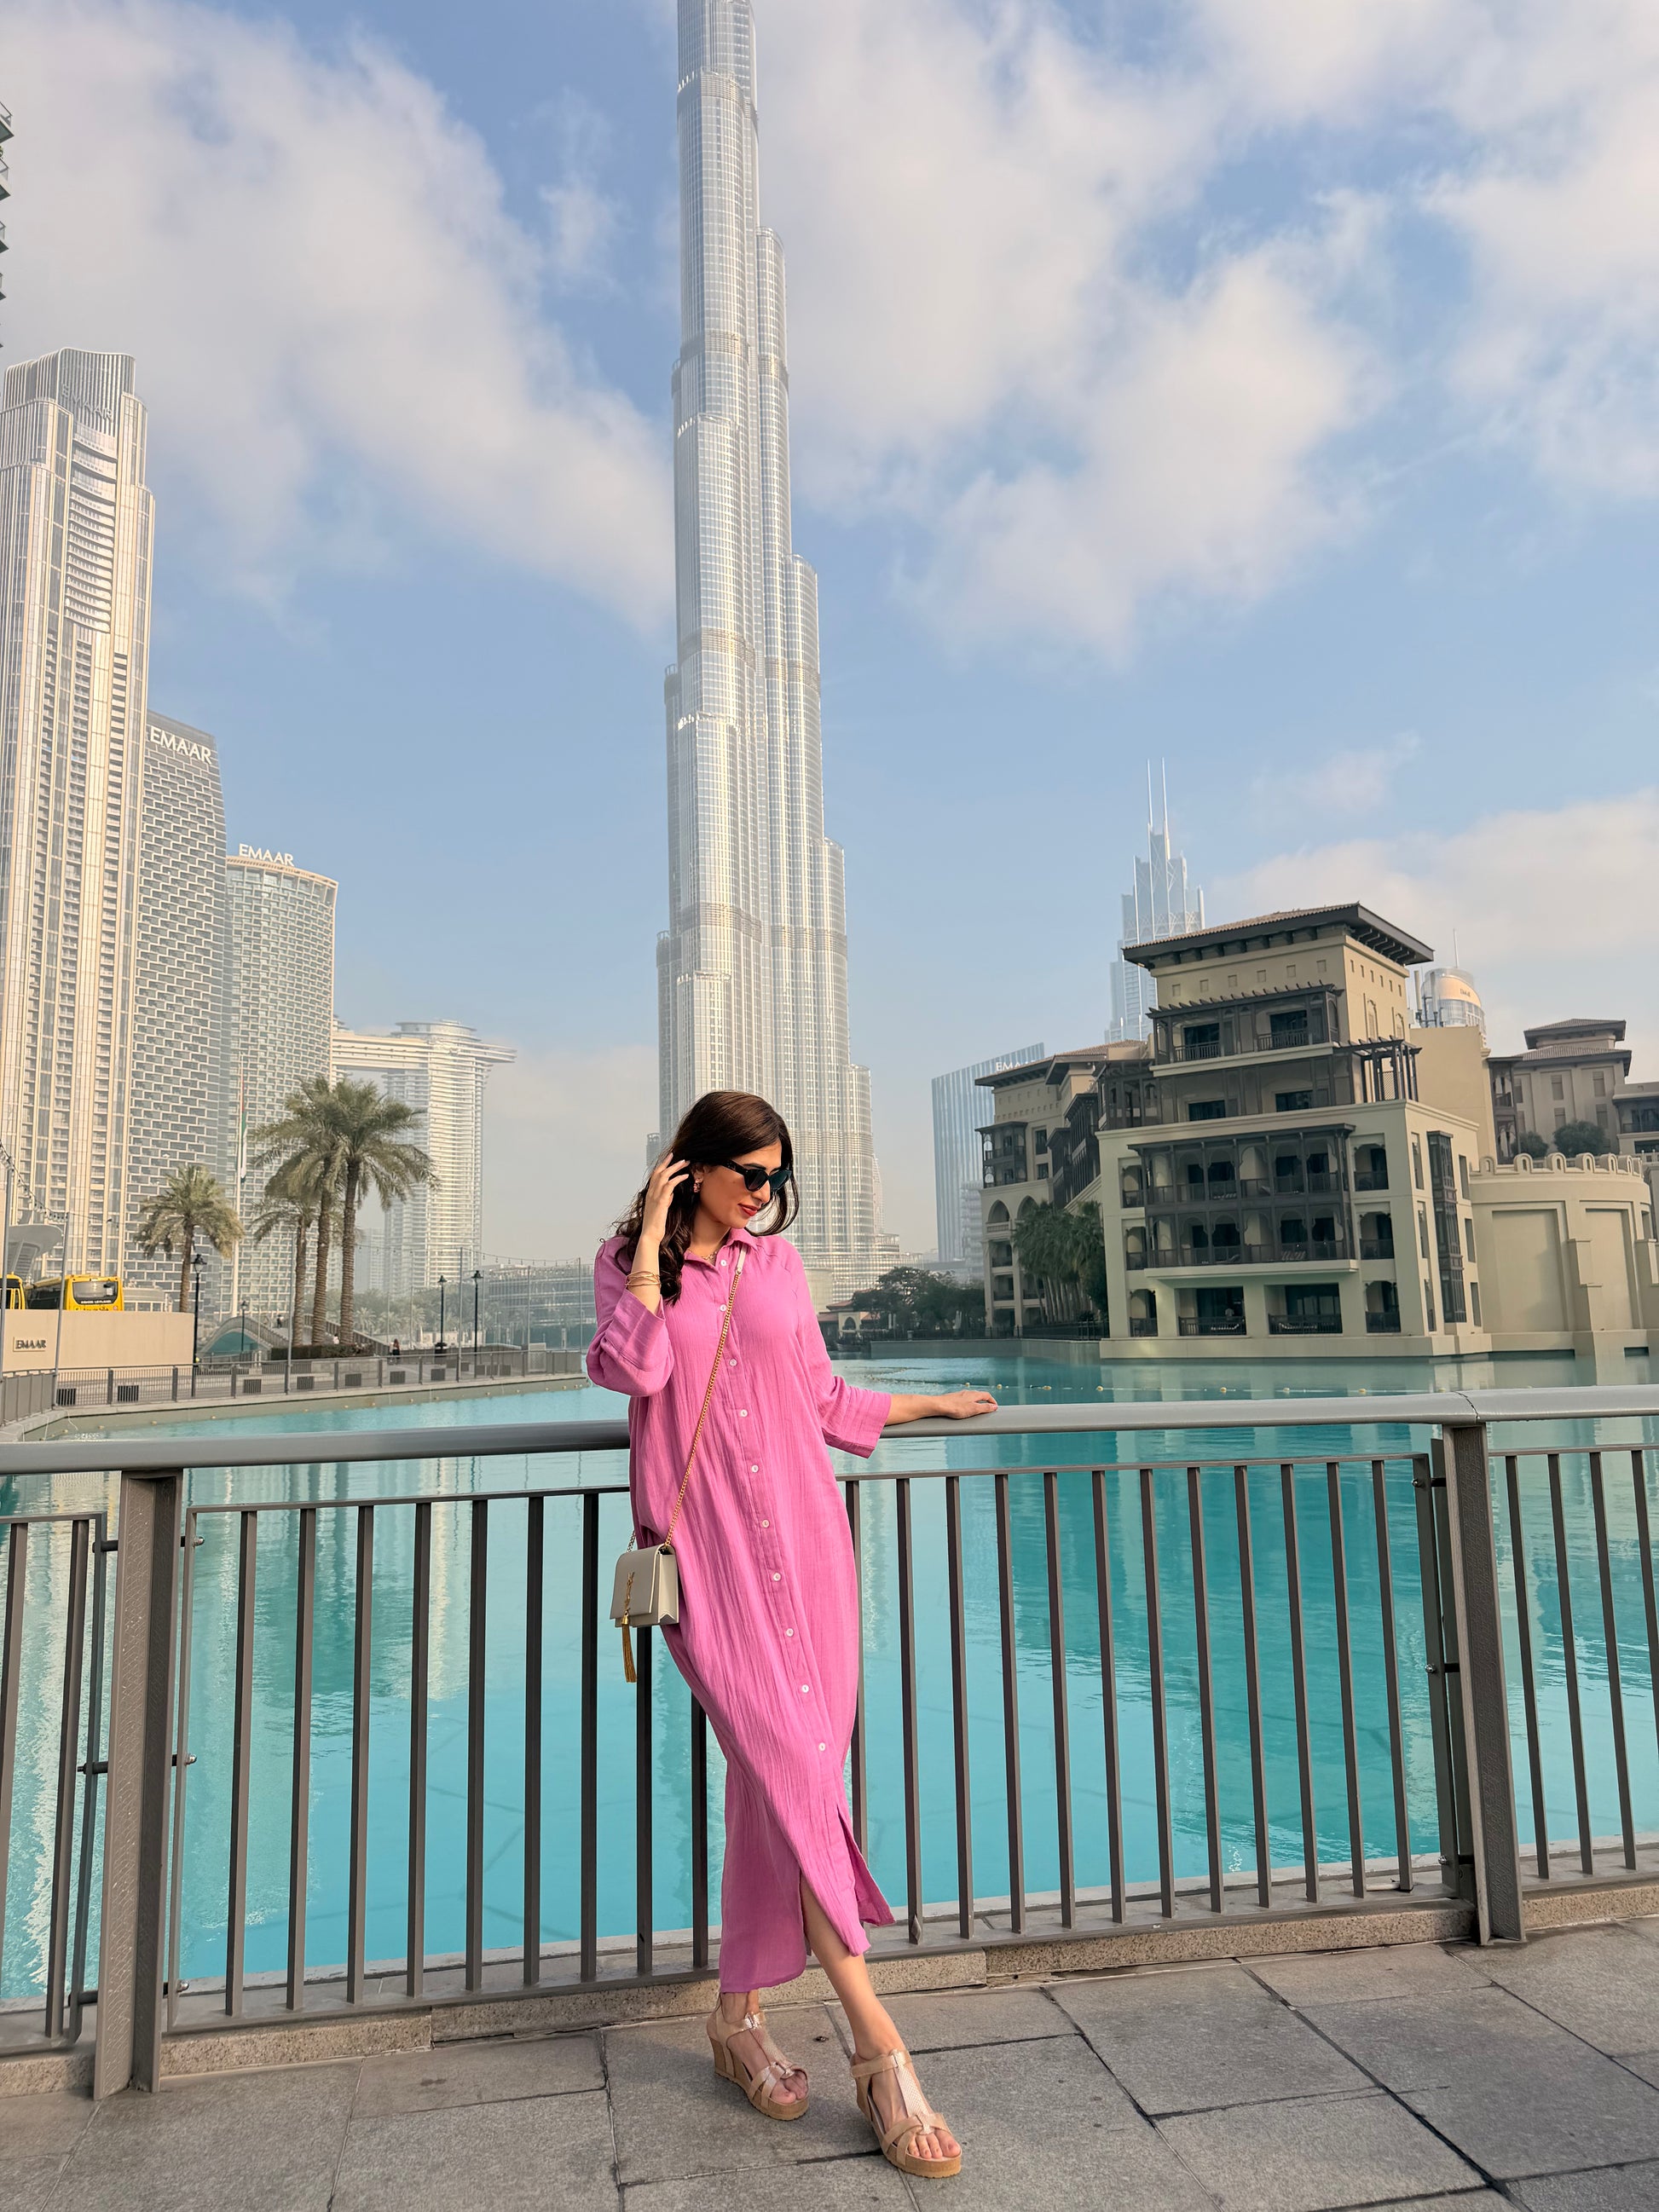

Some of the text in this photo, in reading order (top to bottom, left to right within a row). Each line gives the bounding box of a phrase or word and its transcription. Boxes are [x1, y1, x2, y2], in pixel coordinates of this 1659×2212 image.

[61, 384, 113, 422] EMAAR
[150, 726, 211, 764] EMAAR
[239, 843, 294, 867] EMAAR
[996, 1060, 1036, 1071] EMA
[15, 1339, 47, 1349] EMAAR
